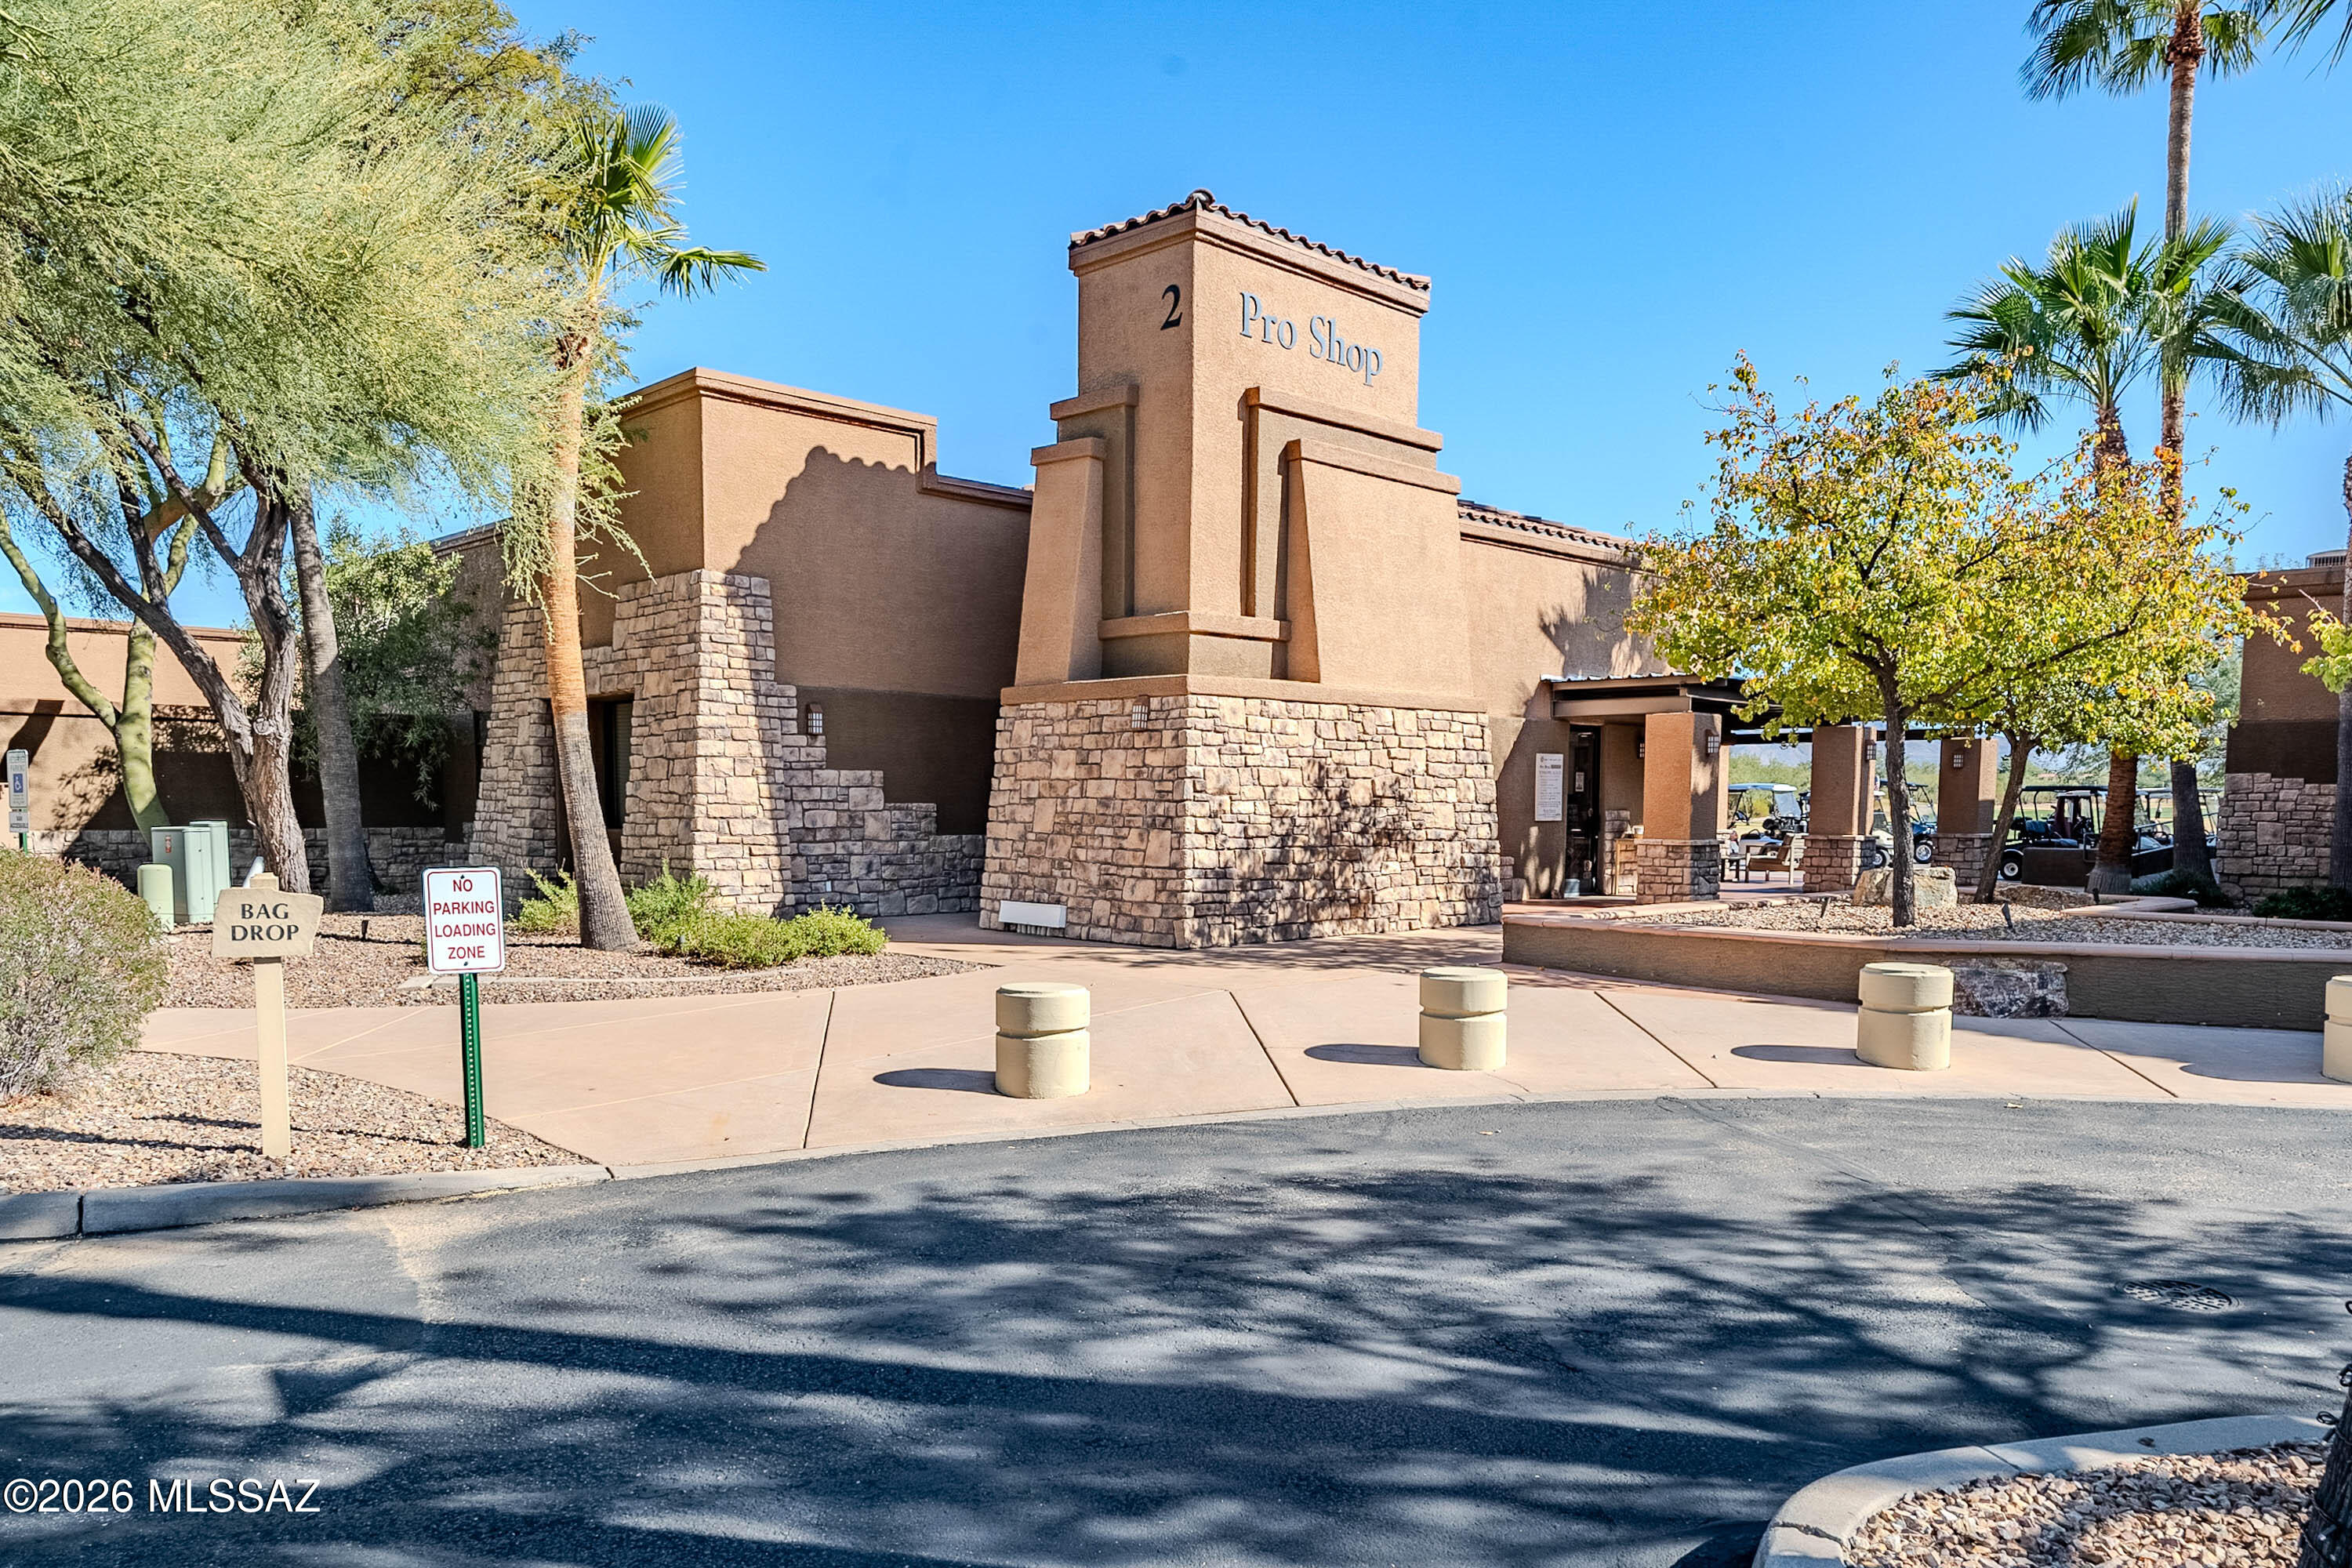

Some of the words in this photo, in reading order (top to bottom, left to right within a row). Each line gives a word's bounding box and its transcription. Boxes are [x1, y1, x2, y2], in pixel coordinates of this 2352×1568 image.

[1160, 284, 1183, 331] 2
[1240, 291, 1298, 350] Pro
[1309, 314, 1383, 387] Shop
[452, 879, 473, 892] NO
[241, 903, 289, 919] BAG
[434, 901, 495, 915] PARKING
[231, 924, 299, 941] DROP
[435, 923, 495, 938] LOADING
[448, 946, 485, 959] ZONE
